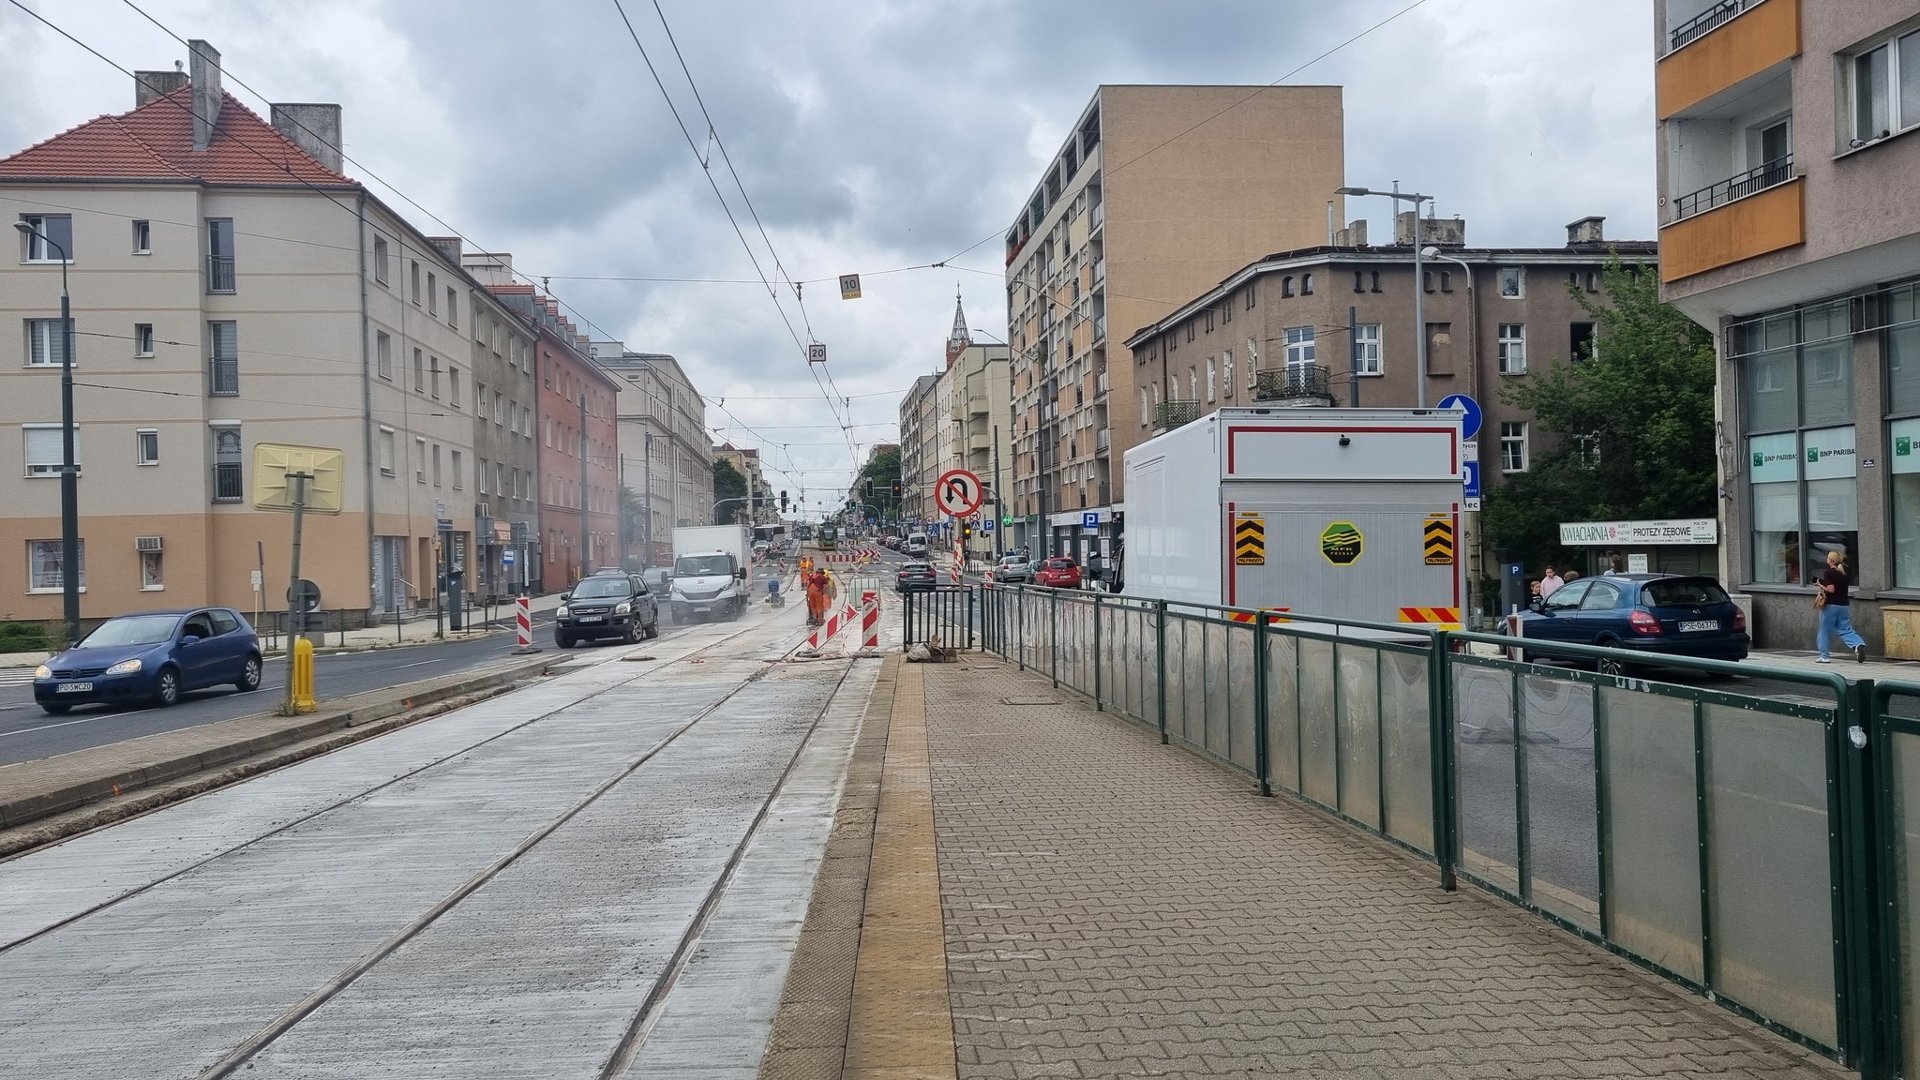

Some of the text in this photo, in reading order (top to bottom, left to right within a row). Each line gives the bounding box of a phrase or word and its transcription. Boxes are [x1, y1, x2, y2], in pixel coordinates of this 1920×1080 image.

[845, 280, 856, 289] 10
[812, 349, 823, 357] 20
[1776, 453, 1798, 461] PARIBA
[1820, 448, 1857, 458] BNP PARIBA
[1086, 514, 1096, 526] P
[986, 521, 993, 529] P
[1561, 526, 1609, 541] KWIACIARNIA
[1633, 527, 1661, 537] PROTEZY
[1662, 526, 1692, 538] ZĘBOWE
[1512, 566, 1519, 574] P
